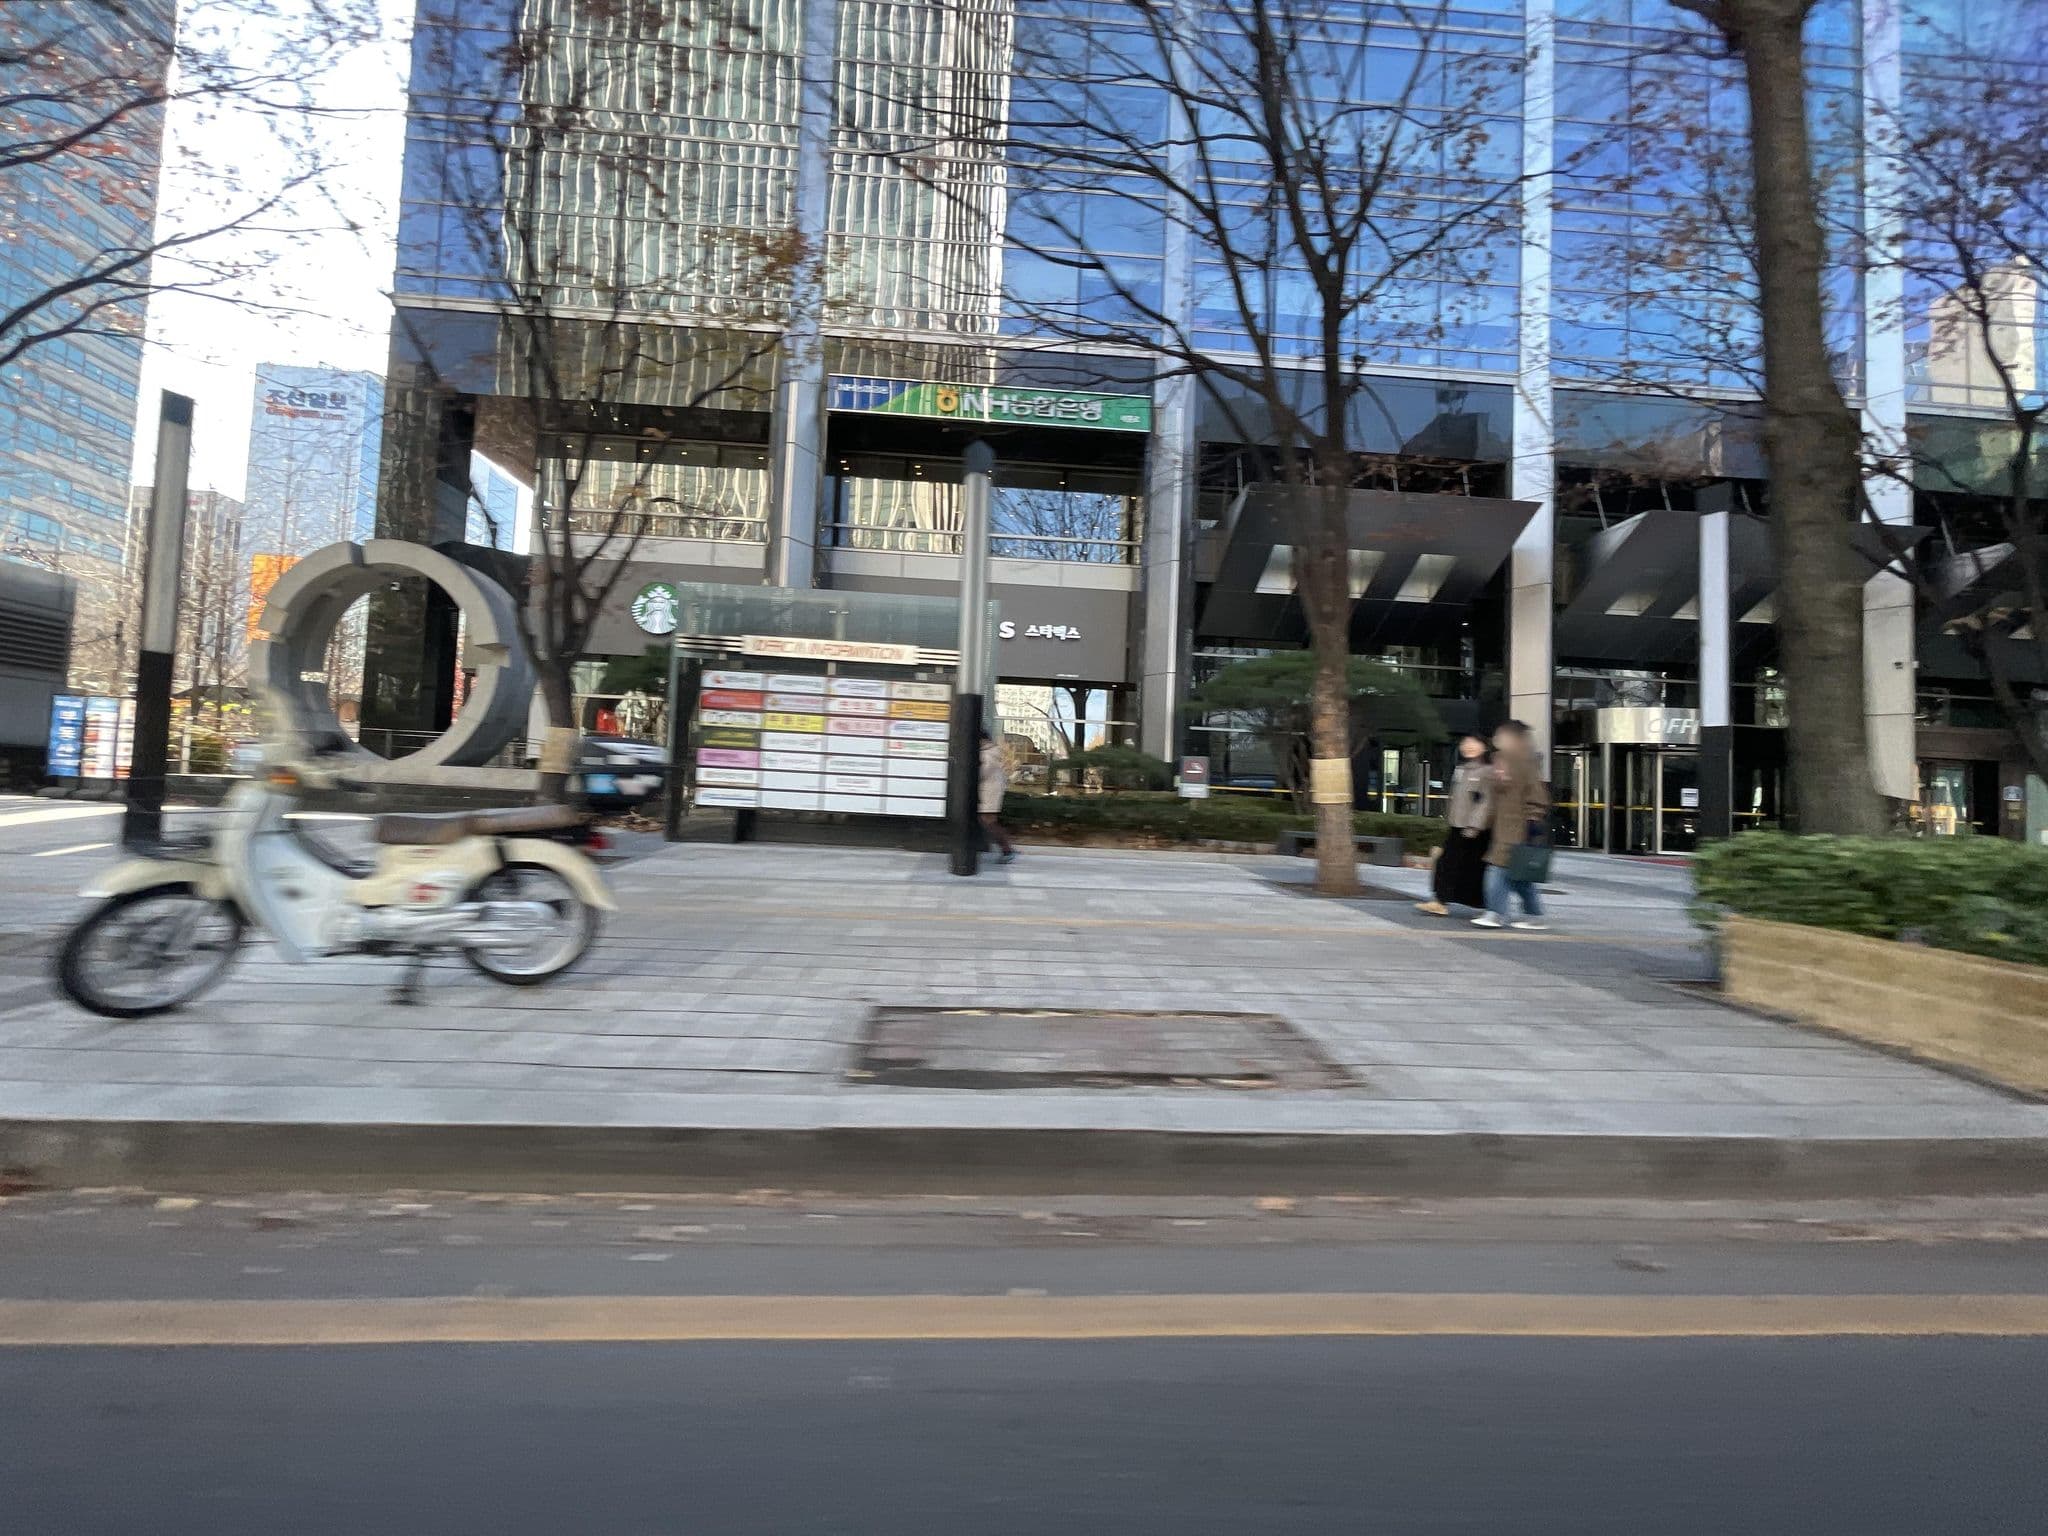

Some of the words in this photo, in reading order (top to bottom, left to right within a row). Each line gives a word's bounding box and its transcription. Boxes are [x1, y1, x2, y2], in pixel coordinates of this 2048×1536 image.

[265, 387, 348, 410] 조선일보
[962, 391, 1103, 422] NH농협은행
[1024, 624, 1081, 640] 스타벅스
